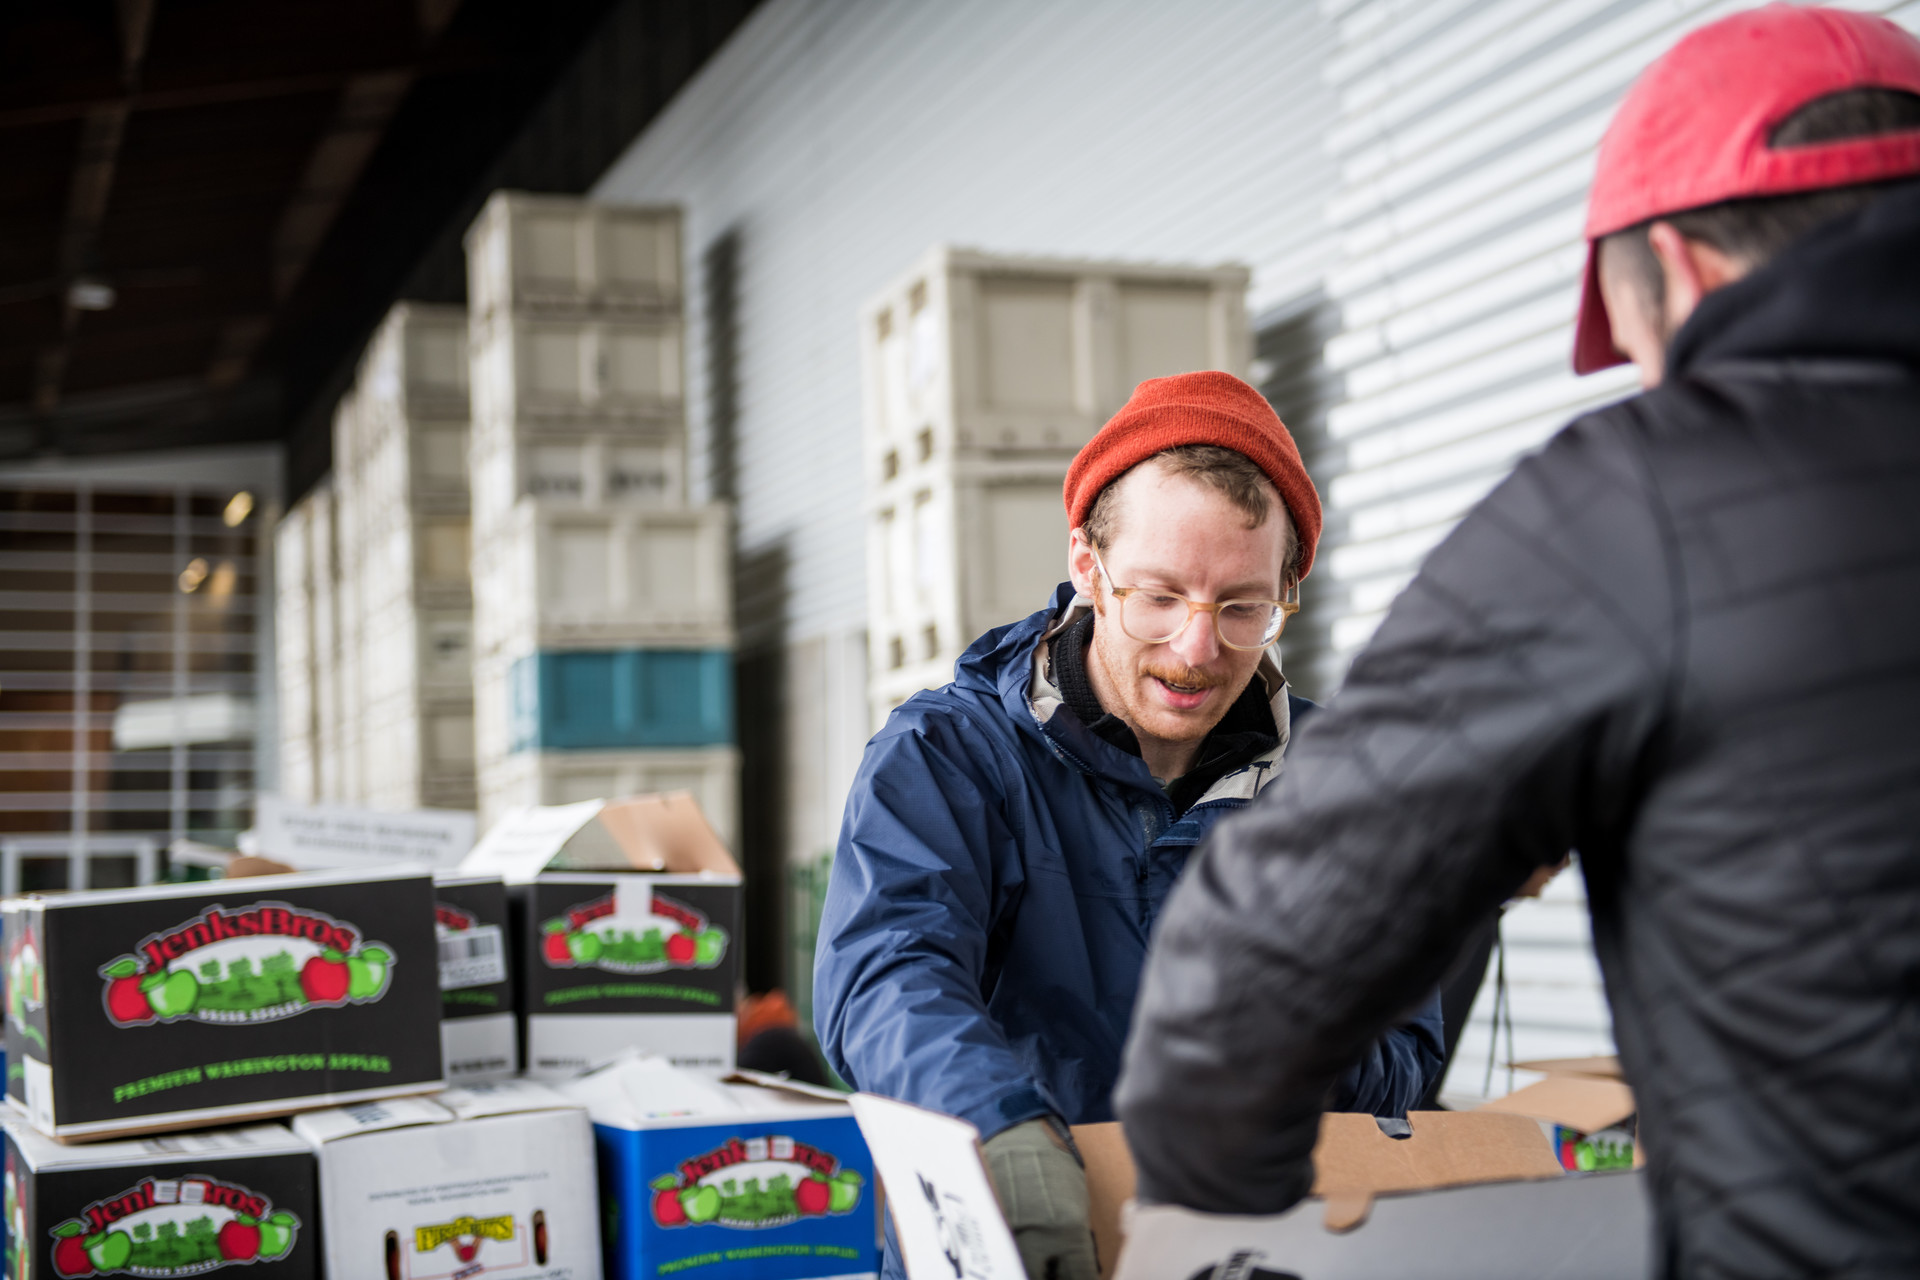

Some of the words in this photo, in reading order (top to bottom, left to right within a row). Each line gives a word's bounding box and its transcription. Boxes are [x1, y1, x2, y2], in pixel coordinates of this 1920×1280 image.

[142, 906, 355, 974] JenksBros
[113, 1066, 202, 1103] PREMIUM
[204, 1053, 326, 1080] WASHINGTON
[328, 1053, 392, 1073] APPLES
